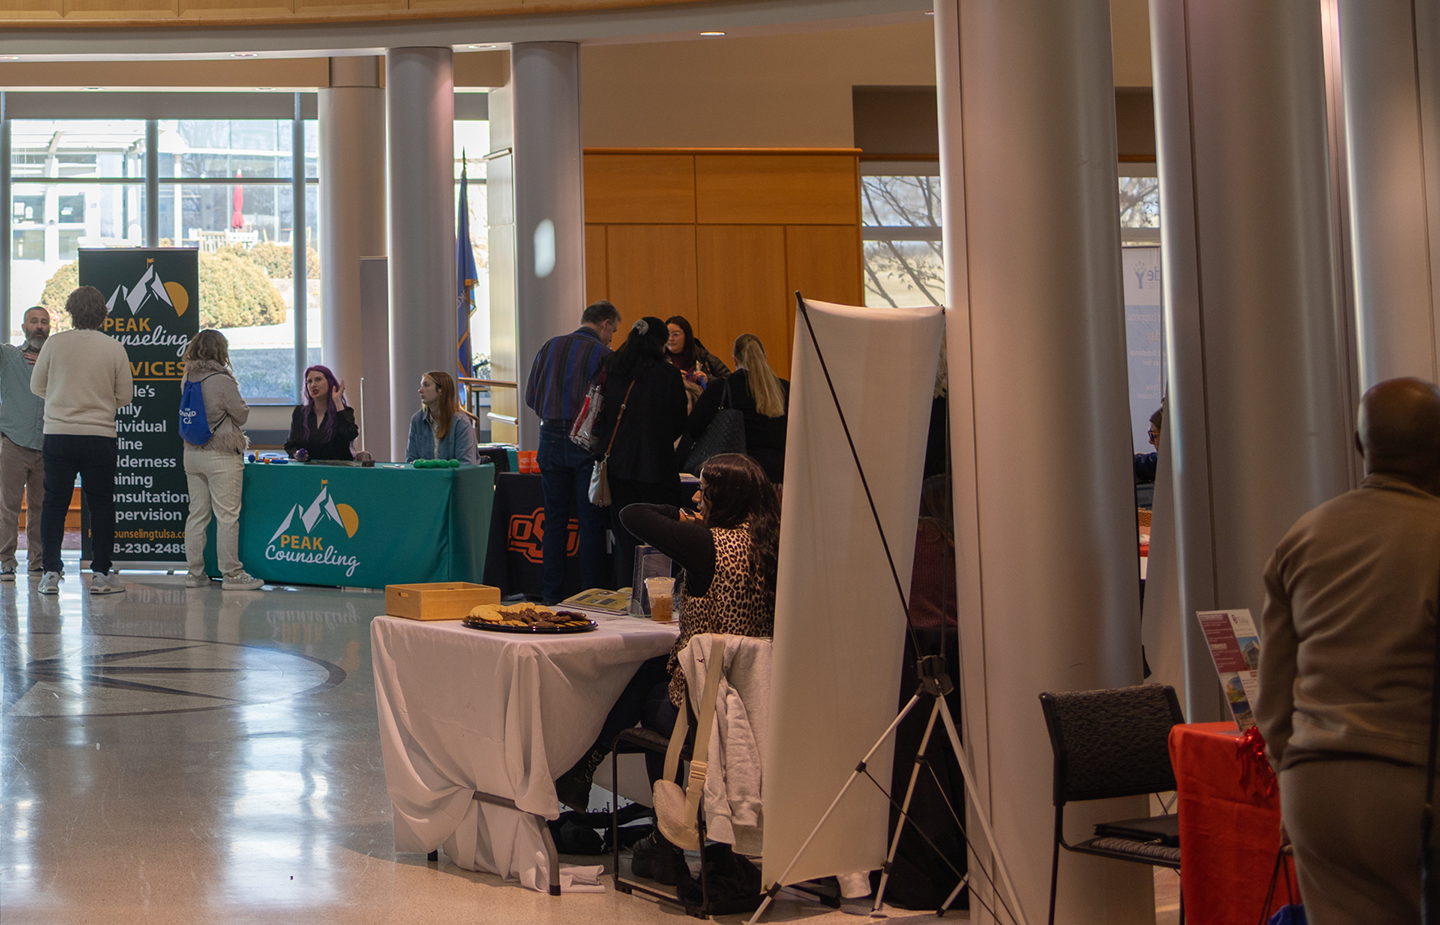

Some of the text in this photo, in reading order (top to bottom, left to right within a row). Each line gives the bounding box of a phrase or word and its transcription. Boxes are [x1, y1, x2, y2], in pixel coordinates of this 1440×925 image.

[103, 317, 151, 332] PEAK
[111, 325, 192, 357] unseling
[130, 361, 187, 376] VICES
[134, 384, 155, 397] le's
[115, 420, 167, 432] ividual
[117, 437, 143, 450] line
[116, 455, 177, 468] lderness
[114, 472, 153, 488] ining
[113, 490, 190, 503] nsultation
[115, 508, 183, 523] pervision
[113, 543, 187, 554] 8-230-2489
[280, 534, 324, 551] PEAK
[264, 544, 361, 577] Counseling
